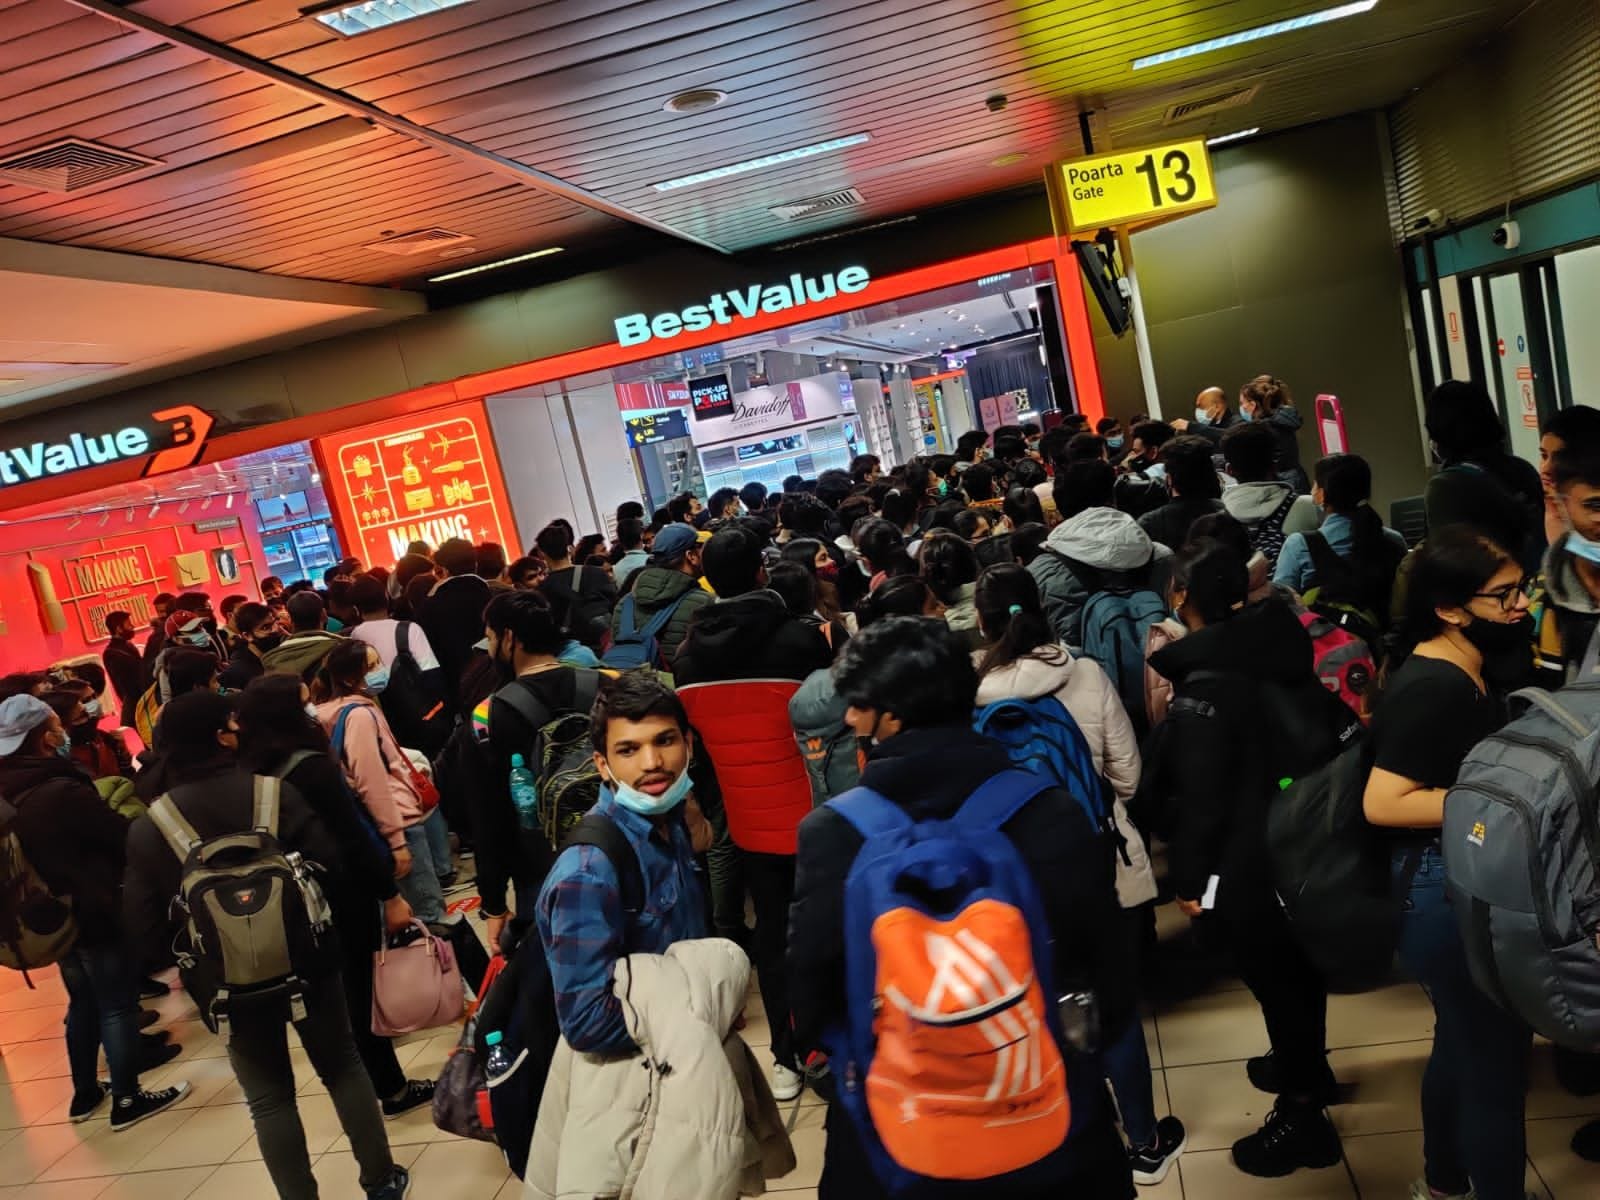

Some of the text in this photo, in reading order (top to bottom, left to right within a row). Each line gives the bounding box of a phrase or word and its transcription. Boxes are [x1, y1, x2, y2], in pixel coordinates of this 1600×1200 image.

[1069, 150, 1196, 207] Poarta 13
[1073, 186, 1104, 200] Gate
[614, 266, 869, 347] BestValue
[692, 385, 728, 396] PICK-UP
[731, 396, 792, 422] Davidoff
[0, 427, 149, 484] tValue
[388, 513, 473, 561] MAKING
[75, 555, 143, 594] MAKING
